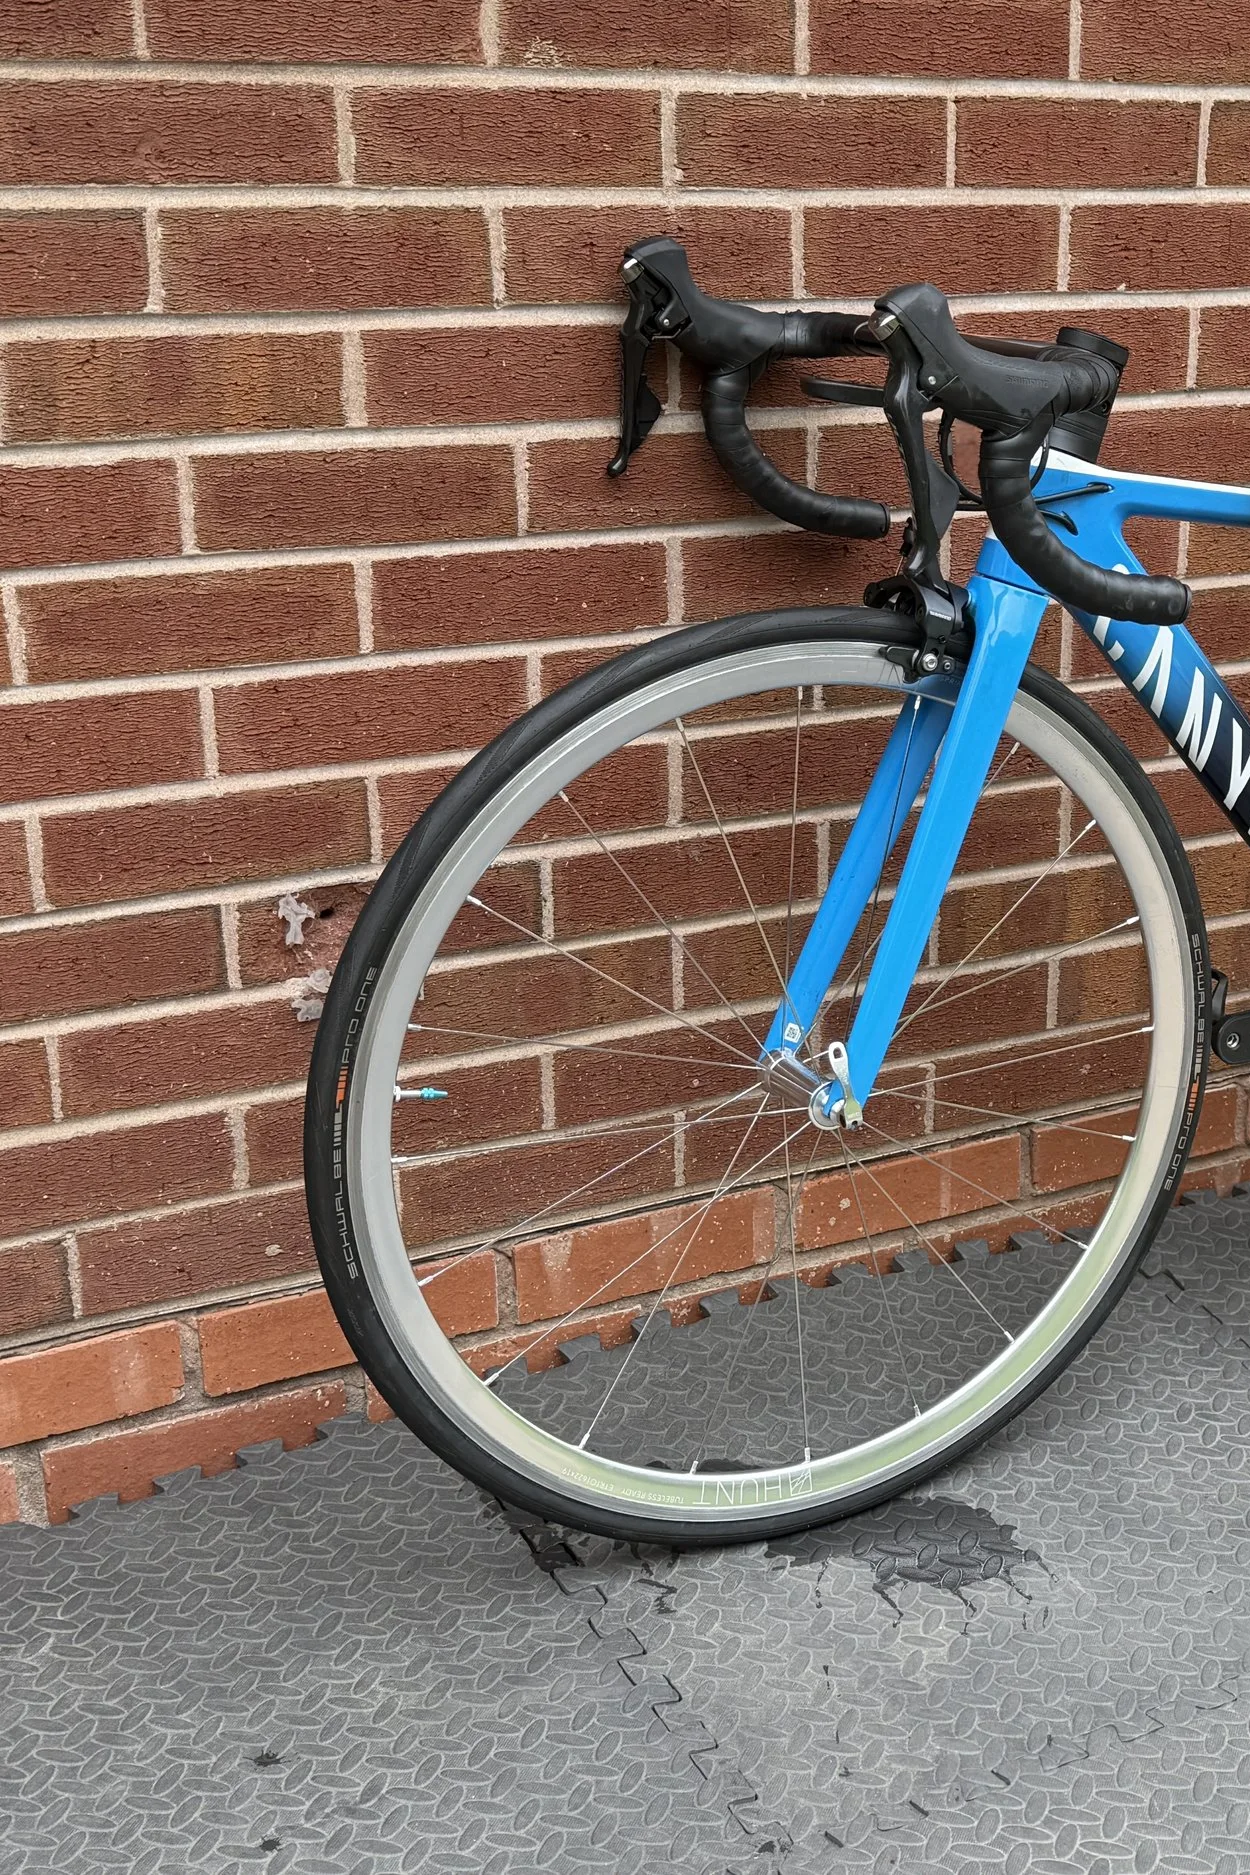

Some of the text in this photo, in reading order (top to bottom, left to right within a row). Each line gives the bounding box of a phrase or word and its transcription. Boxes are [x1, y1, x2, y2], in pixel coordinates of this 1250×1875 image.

[1191, 933, 1206, 1043] SCHWALBE
[332, 1147, 360, 1280] SCHWALBE
[647, 1492, 684, 1504] TUBELESS
[692, 1473, 783, 1505] HUNT
